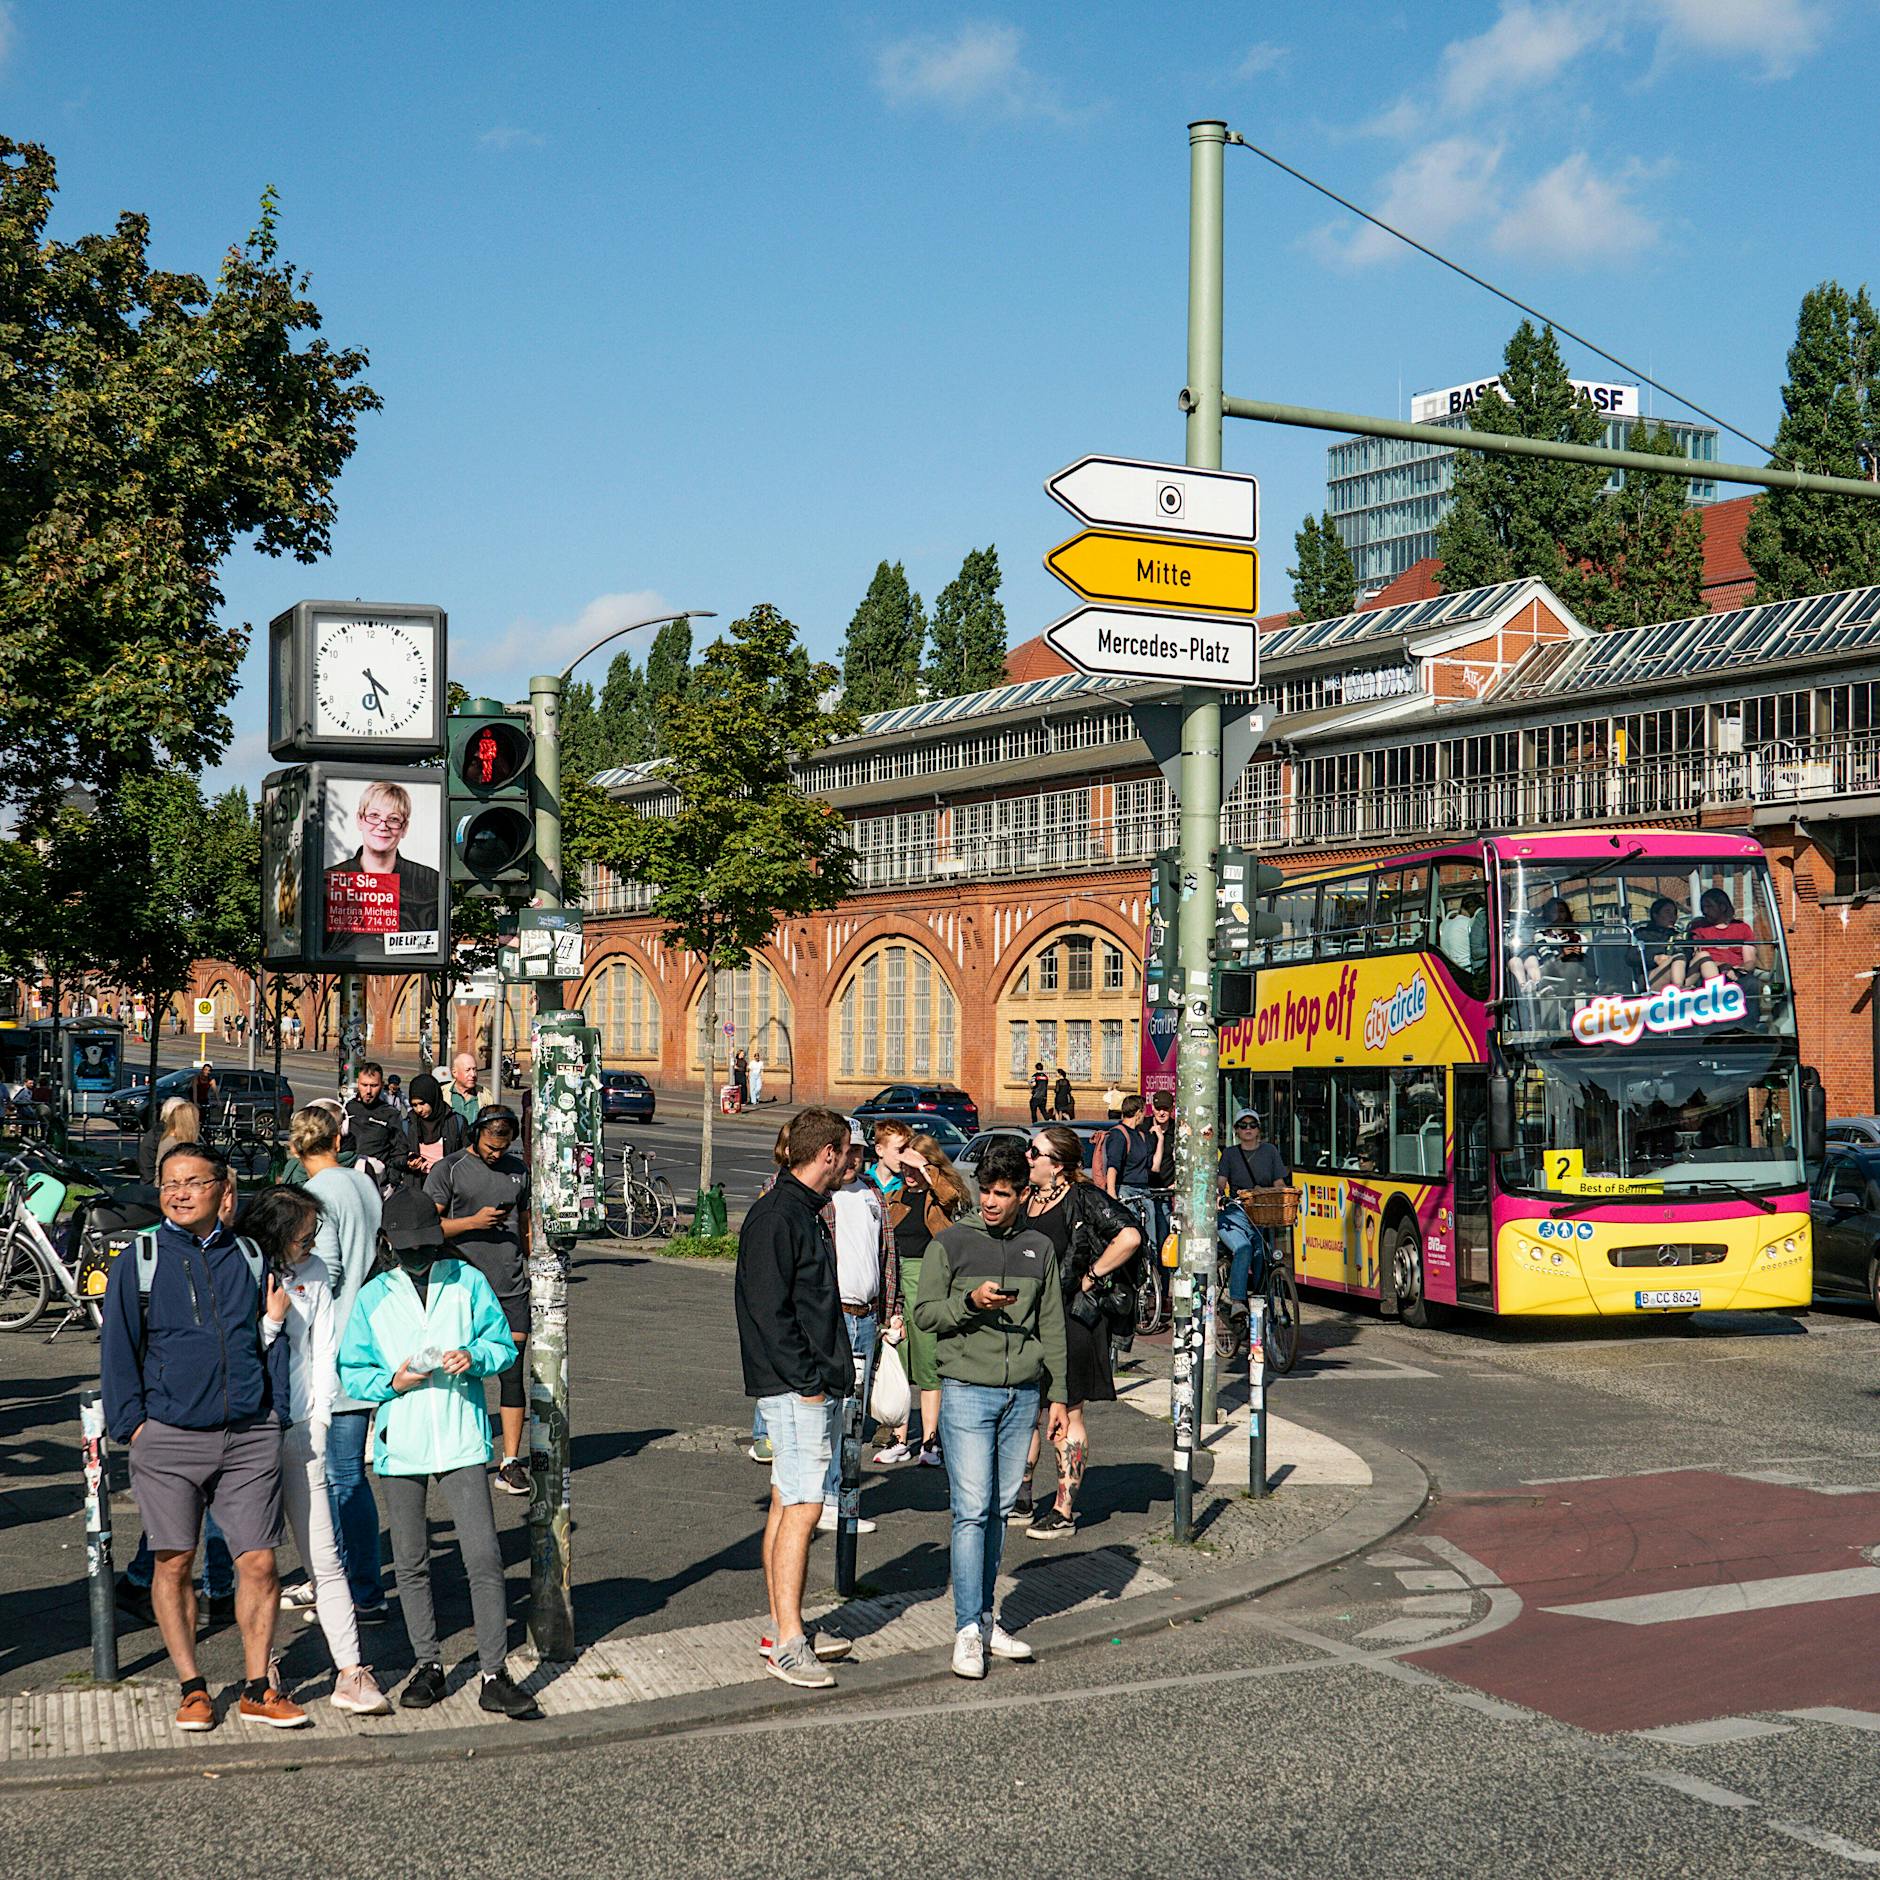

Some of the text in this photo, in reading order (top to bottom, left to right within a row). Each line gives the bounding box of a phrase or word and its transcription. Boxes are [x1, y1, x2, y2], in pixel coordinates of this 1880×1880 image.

[1569, 384, 1623, 411] ASF
[1137, 558, 1191, 587] Mitte
[367, 631, 375, 639] 12
[1098, 628, 1230, 664] Mercedes-Platz
[329, 650, 338, 658] 10
[406, 653, 411, 661] 2
[323, 673, 328, 681] 9
[412, 676, 418, 684] 3
[390, 713, 395, 721] 5
[271, 787, 300, 826] LSD
[330, 874, 378, 888] Für Sie
[330, 888, 394, 905] in Europa
[329, 906, 398, 917] Martina Michels
[330, 915, 397, 926] Tel. 227 714 06
[389, 936, 404, 947] DIE
[1258, 1002, 1280, 1046] on
[1284, 990, 1321, 1052] hop
[1325, 964, 1357, 1041] off
[1365, 977, 1425, 1043] city circle
[1579, 984, 1739, 1036] city circle
[1145, 1076, 1176, 1090] SIGHTSEEING
[1556, 1157, 1571, 1180] 2
[1580, 1182, 1602, 1193] Best
[1605, 1182, 1616, 1193] of
[1305, 1235, 1344, 1253] MULTI-LANGUAGE
[1642, 1291, 1699, 1304] B CC 8624
